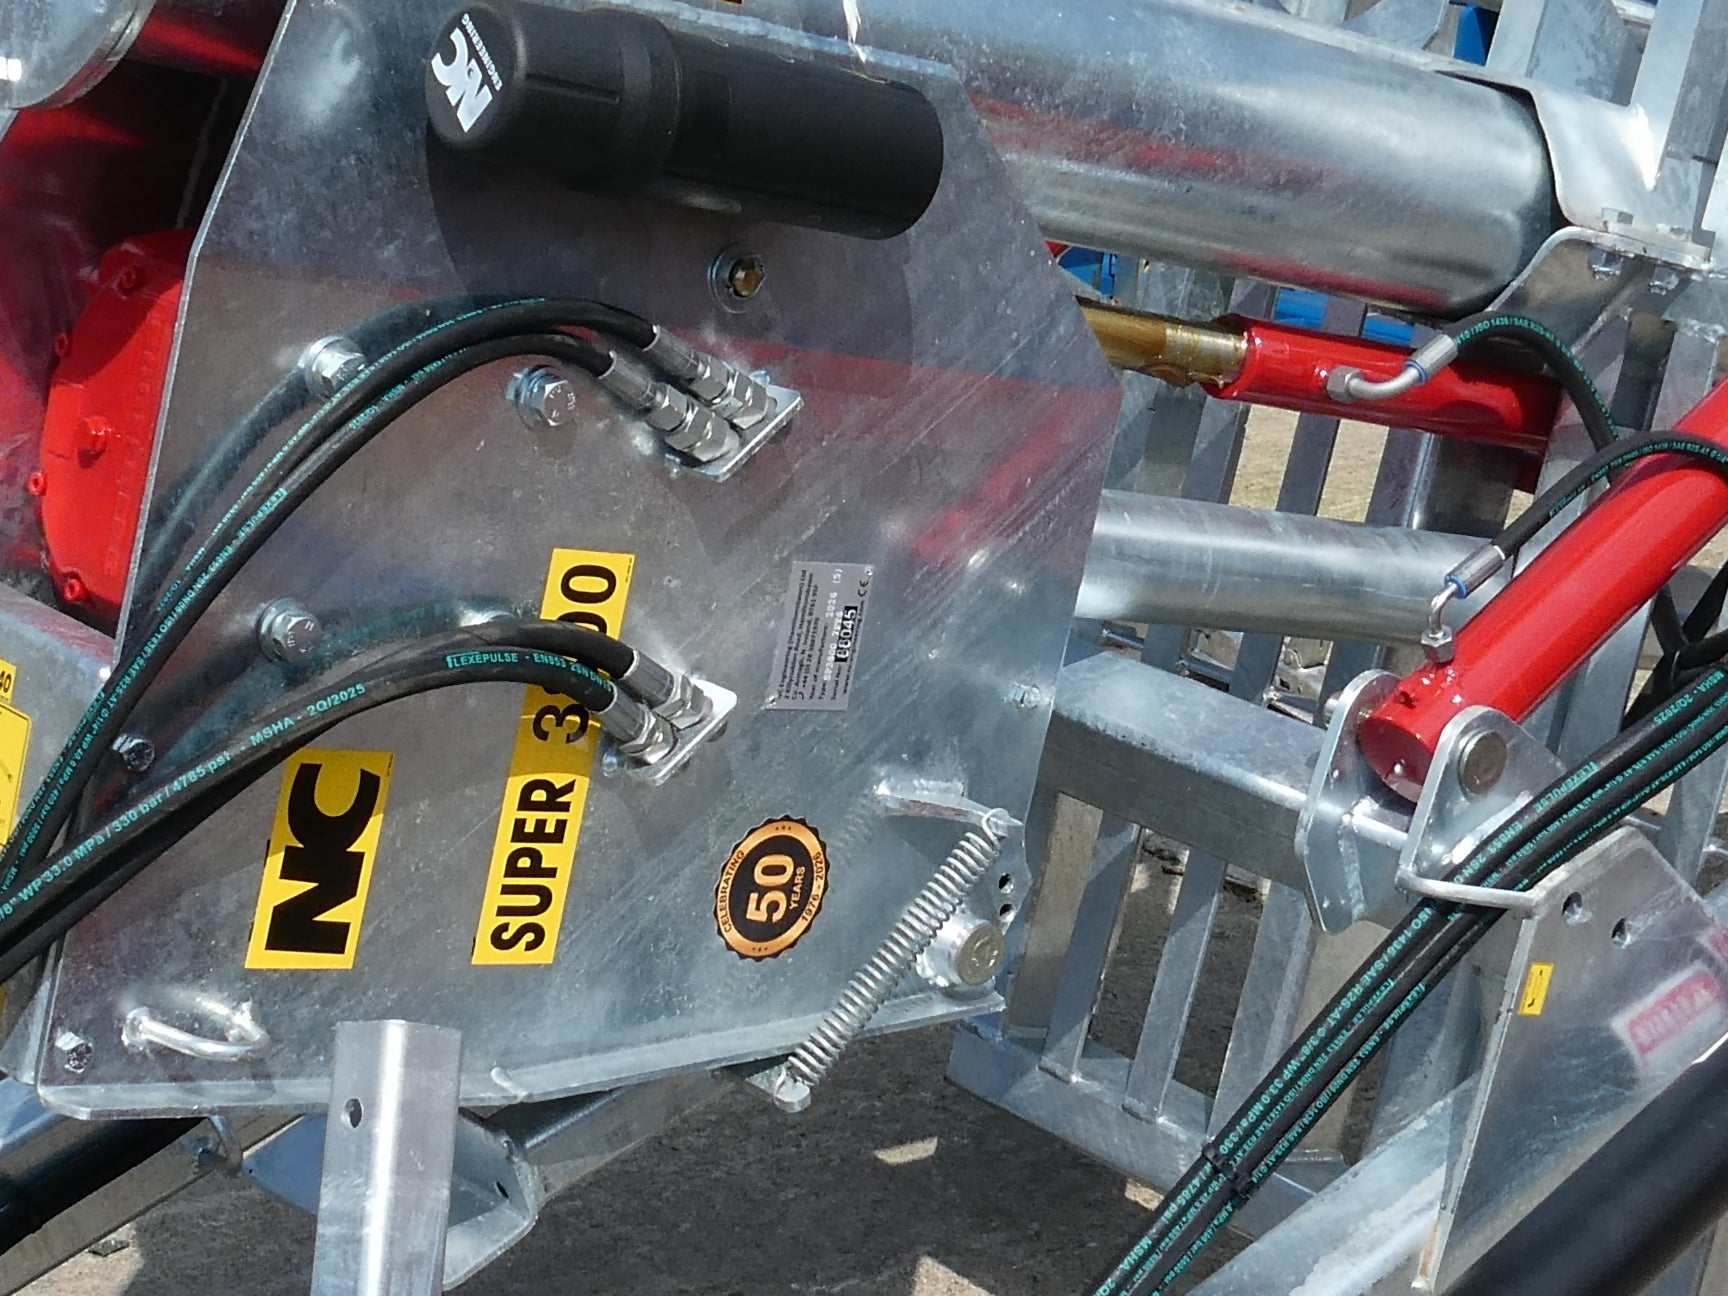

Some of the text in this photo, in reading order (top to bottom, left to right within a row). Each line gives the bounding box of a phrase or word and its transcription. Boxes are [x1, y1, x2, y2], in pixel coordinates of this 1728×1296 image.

[431, 27, 493, 133] NC
[445, 651, 567, 669] FLEXEPULSE EN853
[1651, 691, 1694, 727] 2Q/2025
[19, 877, 42, 902] WP
[41, 854, 74, 884] 33.0
[73, 832, 107, 861] MPa
[111, 807, 139, 832] 330
[139, 791, 164, 815] bar
[171, 766, 207, 794] 4785
[208, 749, 232, 775] psi
[249, 715, 296, 746] MSHA
[306, 682, 367, 717] 2Q/2025
[1530, 760, 1599, 813] FLEXEPULSE
[1484, 815, 1522, 857] EN853
[264, 763, 382, 955] NC
[490, 777, 577, 953] SUPER
[1459, 850, 1487, 880] 2SN
[718, 850, 745, 933] CELEBRATING
[746, 854, 795, 923] 50
[789, 866, 806, 910] YEARS
[801, 851, 825, 923] 1976 2026
[1409, 905, 1432, 930] ISO
[1385, 926, 1414, 957] 1436
[1359, 957, 1386, 986] SAE
[1323, 981, 1365, 1028] R2S-AT
[1278, 1057, 1300, 1080] WP
[1258, 1076, 1285, 1106] 33.0
[1238, 1100, 1265, 1129] MPa
[1216, 1130, 1239, 1155] 330
[1174, 1174, 1203, 1206] 4785
[1156, 1200, 1180, 1225] psi
[1118, 1234, 1153, 1272] MSHA
